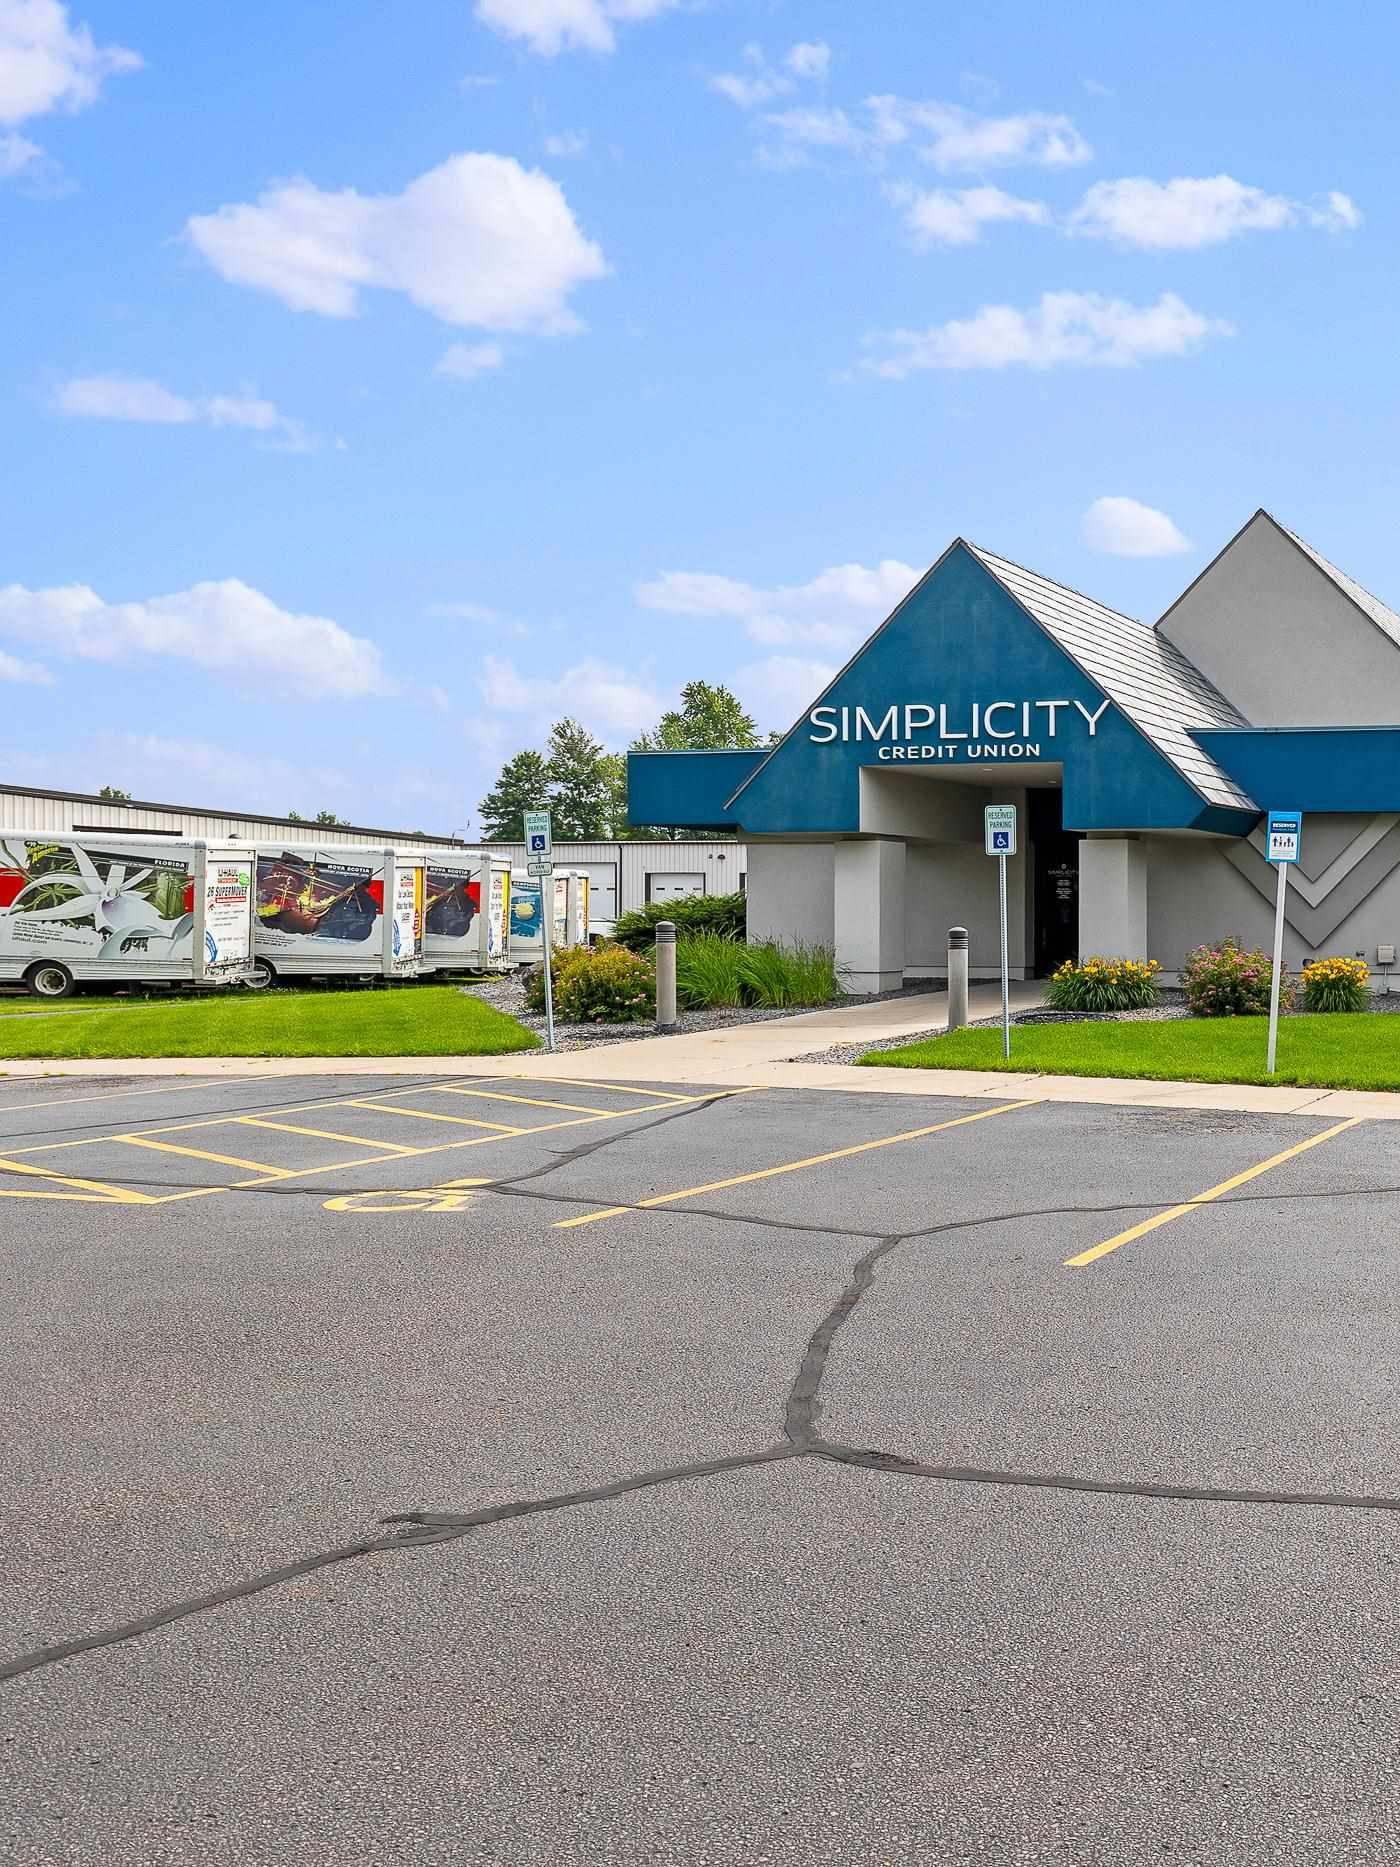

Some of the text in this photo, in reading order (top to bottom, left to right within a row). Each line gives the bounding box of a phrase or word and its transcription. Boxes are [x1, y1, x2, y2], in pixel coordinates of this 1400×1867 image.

[809, 699, 1112, 743] SIMPLICITY
[878, 743, 1040, 760] CREDIT UNION
[988, 811, 1012, 819] RESERVED
[527, 816, 548, 824] RESERVED
[989, 821, 1012, 829] PARKING
[154, 859, 186, 868] FLORIDA
[215, 885, 248, 897] SUPERMOVER
